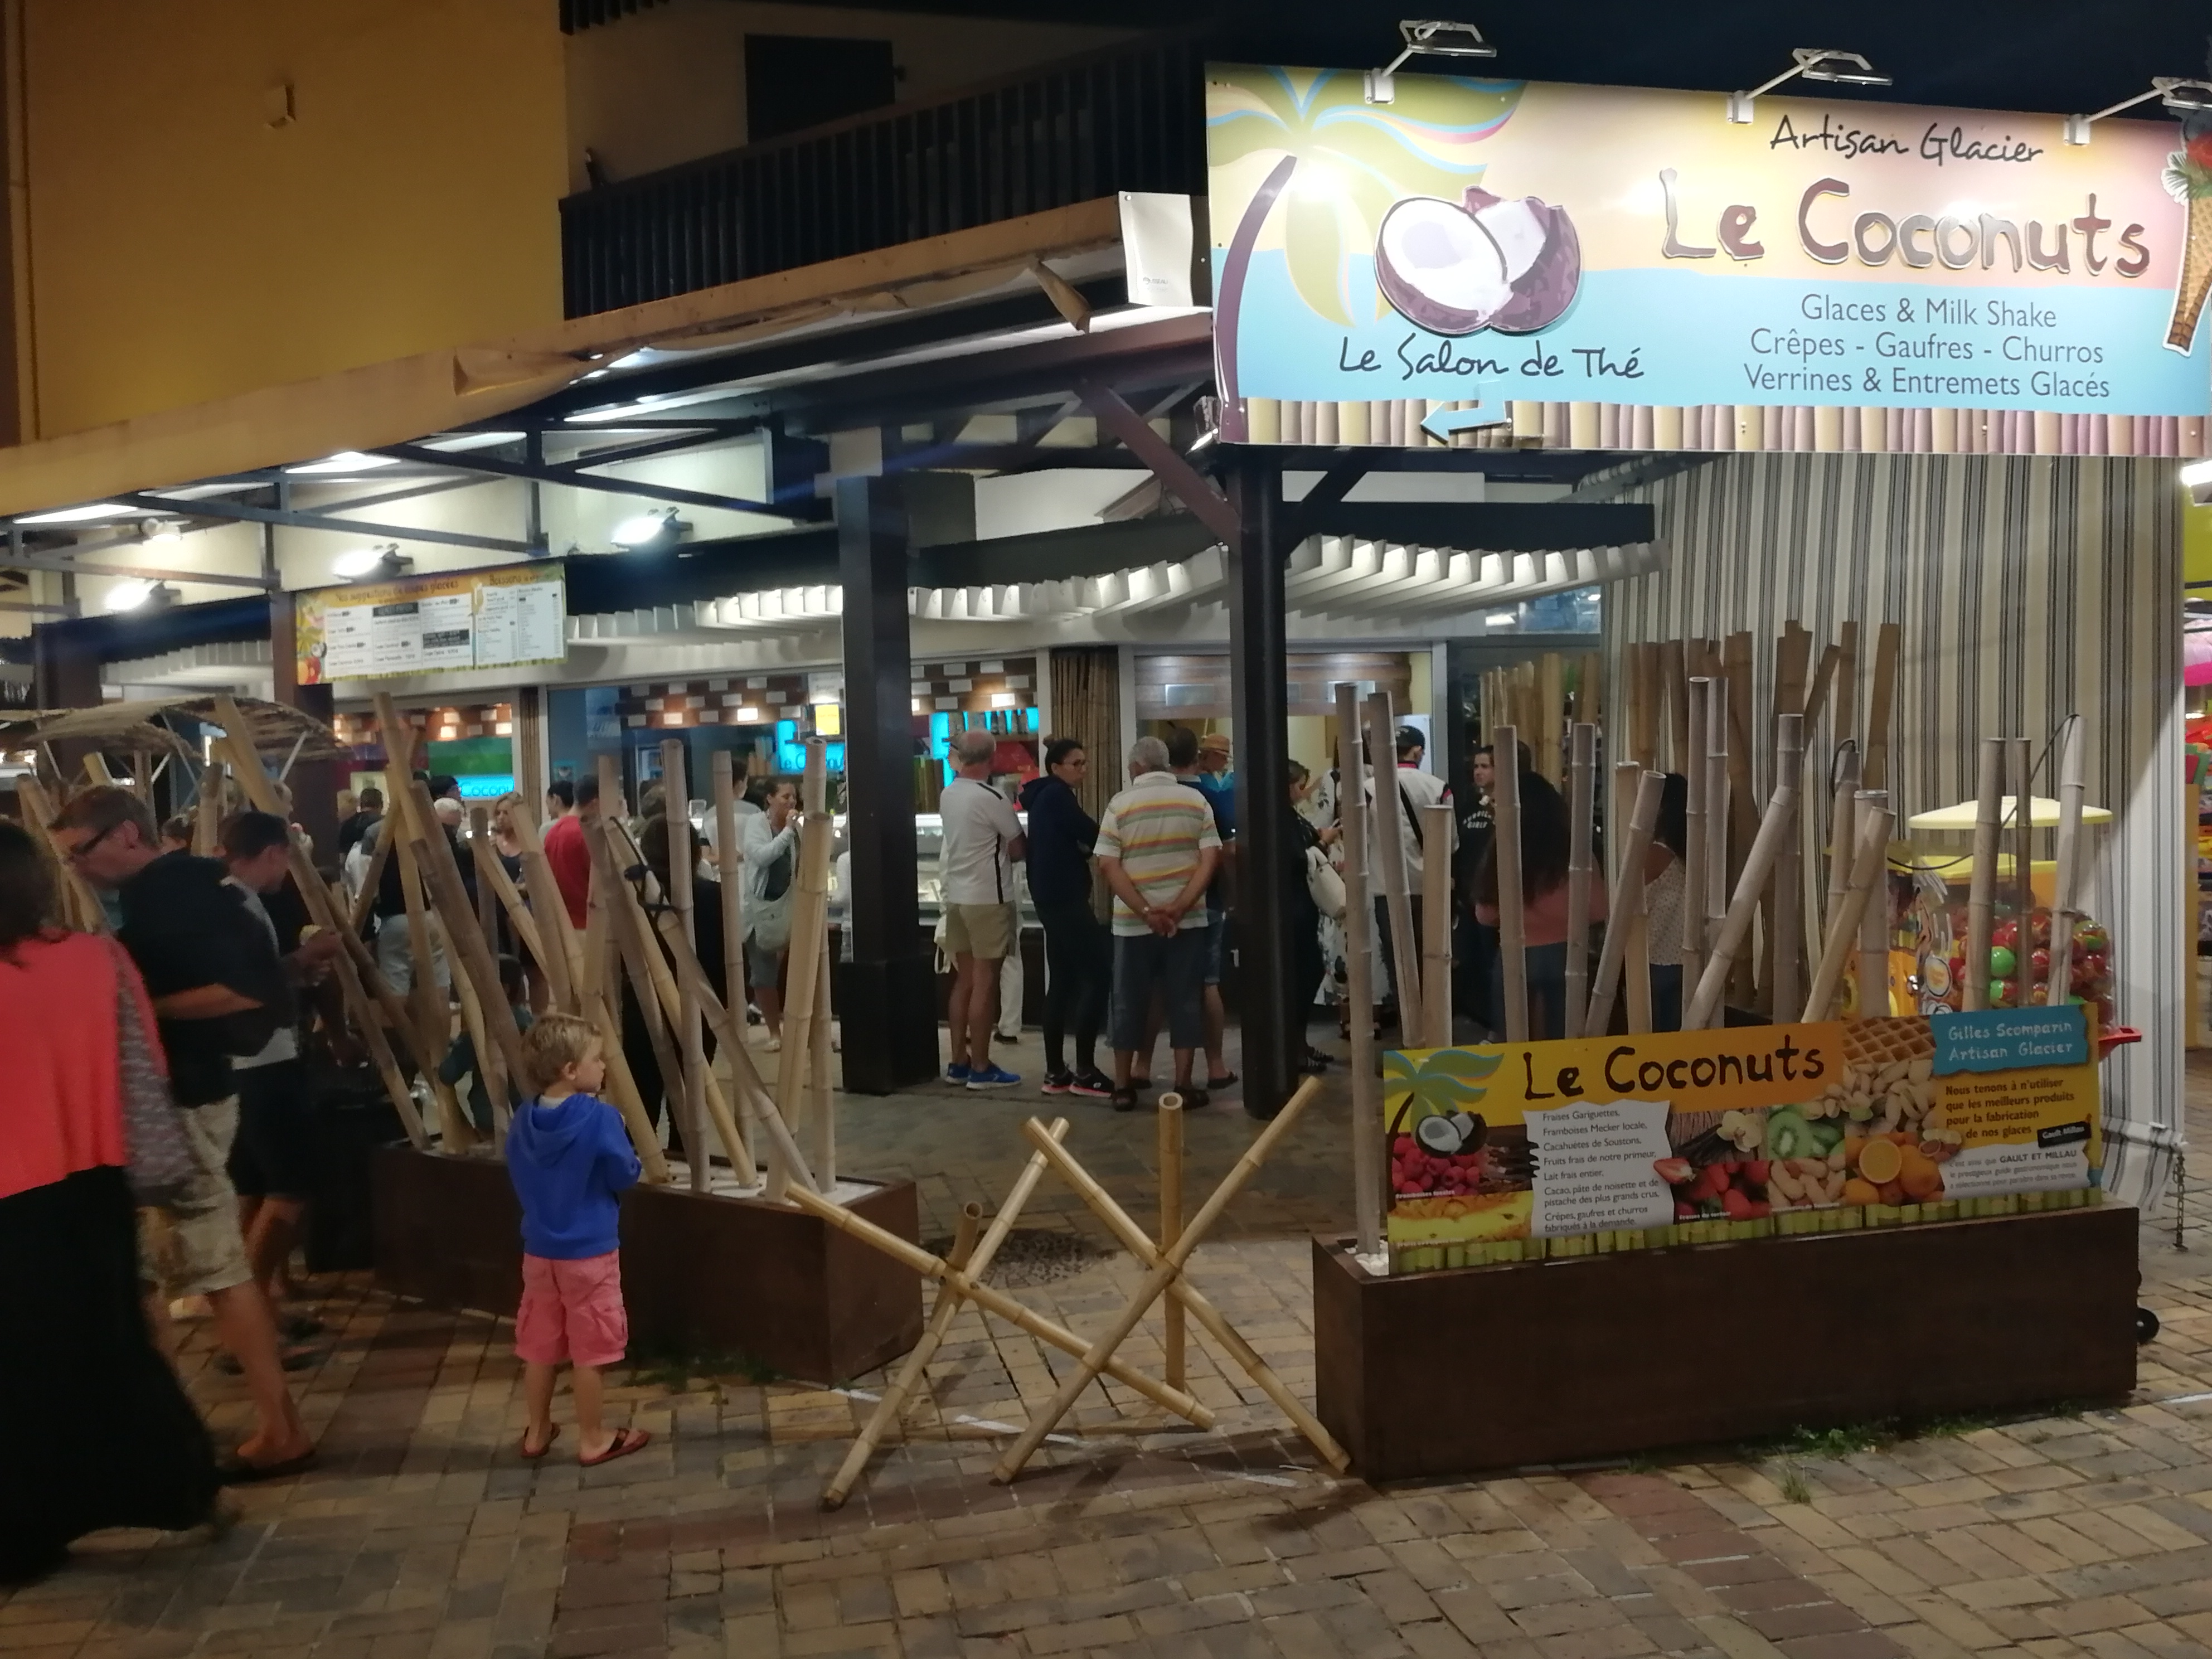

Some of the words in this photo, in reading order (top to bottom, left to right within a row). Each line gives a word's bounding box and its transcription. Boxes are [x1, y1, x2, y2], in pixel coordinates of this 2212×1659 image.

[1770, 114, 1909, 160] Artisan
[1919, 122, 2044, 167] Glacier
[1658, 167, 1765, 261] Le
[1798, 177, 2151, 278] Coconuts
[1801, 293, 1886, 323] Glaces
[1896, 298, 1916, 323] &
[1925, 298, 1978, 326] Milk
[1987, 300, 2058, 328] Shake
[1750, 328, 1846, 363] Crêpes
[1875, 331, 1974, 361] Gaufres
[2002, 336, 2104, 365] Churros
[1340, 336, 1382, 372] Le
[1397, 333, 1509, 381] Salon
[1520, 341, 1564, 376] de
[1571, 347, 1645, 380] Thé
[1743, 363, 1852, 393] Verrines
[1862, 368, 1882, 394] &
[1892, 367, 2020, 398] Entremets
[2030, 370, 2111, 400] Glacés
[1948, 1025, 1991, 1041] Gilles
[1996, 1021, 2073, 1038] Scomparin
[1948, 1046, 2007, 1061] Artisan
[2018, 1041, 2073, 1056] Glacier
[1523, 1051, 1585, 1100] Le
[1604, 1035, 1825, 1094] Coconuts
[1946, 1085, 1971, 1095] Nous
[1974, 1083, 2007, 1094] tenons
[2011, 1080, 2017, 1090] à
[2020, 1078, 2064, 1090] n'utiliser
[1946, 1102, 1964, 1113] que
[1968, 1098, 1982, 1109] les
[1985, 1095, 2030, 1108] meilleurs
[2034, 1092, 2075, 1110] produits
[1542, 1113, 1570, 1122] Fraises
[1946, 1116, 1970, 1128] pour
[1973, 1113, 1982, 1124] la
[1986, 1109, 2039, 1123] fabrication
[1542, 1126, 1588, 1137] Framboises
[1966, 1127, 1978, 1139] de
[1982, 1128, 1999, 1137] nos
[2002, 1125, 2032, 1139] glaces
[1592, 1139, 1602, 1148] de
[1544, 1157, 1566, 1166] Fruits
[1568, 1155, 1585, 1164] frais
[1587, 1154, 1597, 1163] de
[1599, 1153, 1622, 1162] notre
[1999, 1153, 2029, 1163] GAULT
[2045, 1149, 2077, 1160] MILLAU
[1544, 1172, 1558, 1181] Lait
[1560, 1170, 1577, 1179] frais
[1592, 1183, 1602, 1192] de
[1604, 1181, 1636, 1191] noisette
[1648, 1178, 1659, 1187] de
[1544, 1197, 1577, 1209] pistache
[1579, 1195, 1593, 1204] des
[1595, 1194, 1611, 1205] plus
[1613, 1191, 1638, 1203] grands
[1618, 1205, 1648, 1215] churros
